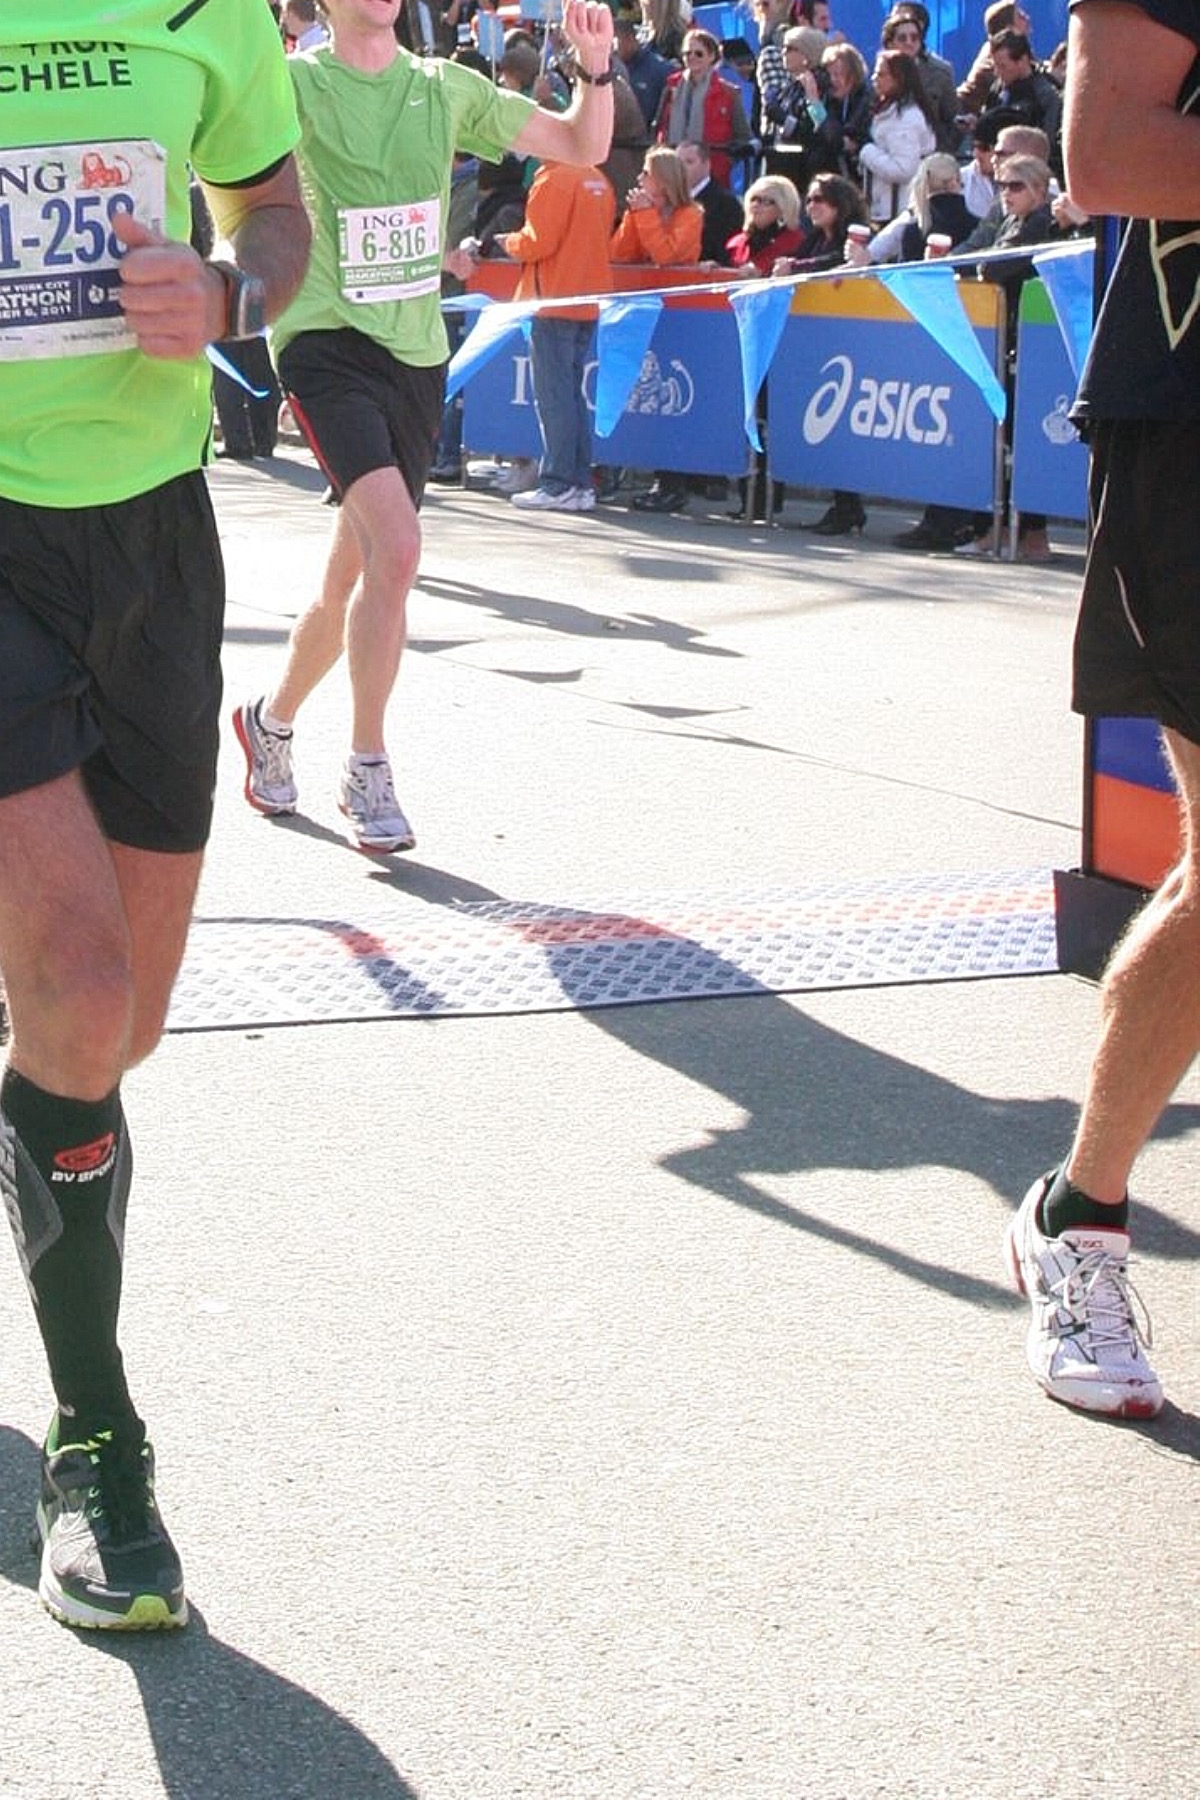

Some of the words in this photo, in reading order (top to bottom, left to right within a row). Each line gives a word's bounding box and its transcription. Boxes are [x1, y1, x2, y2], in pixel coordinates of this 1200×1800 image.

[362, 212, 404, 230] ING
[362, 226, 426, 262] 6-816
[45, 280, 71, 290] CITY
[41, 304, 72, 316] 2011
